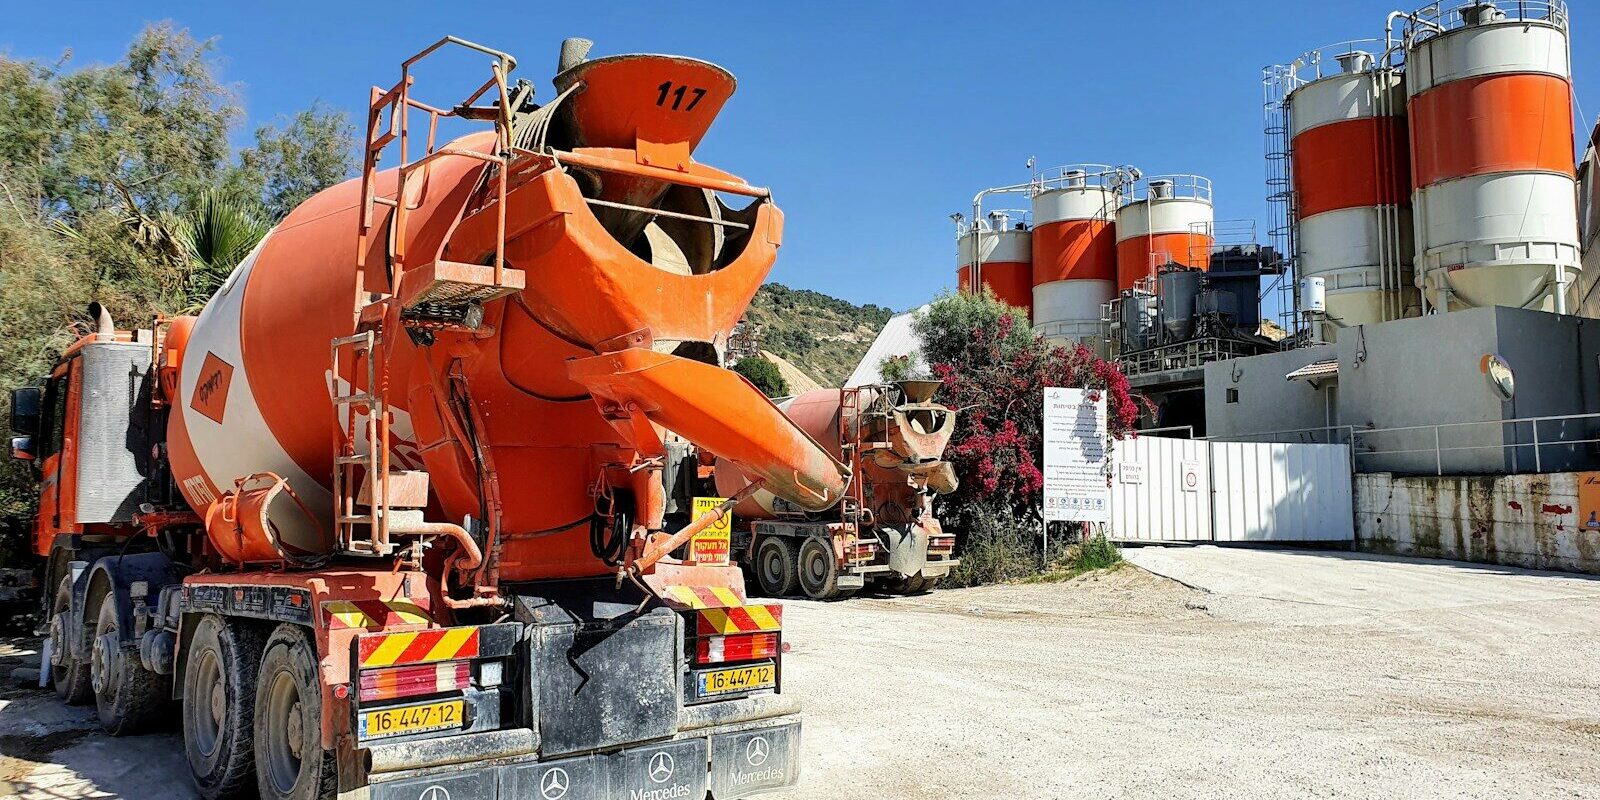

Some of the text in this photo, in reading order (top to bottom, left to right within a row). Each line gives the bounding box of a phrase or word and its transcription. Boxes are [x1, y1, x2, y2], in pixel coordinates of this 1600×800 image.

[656, 81, 707, 111] 117
[730, 766, 784, 787] Mercedes
[630, 783, 691, 800] Mercedes
